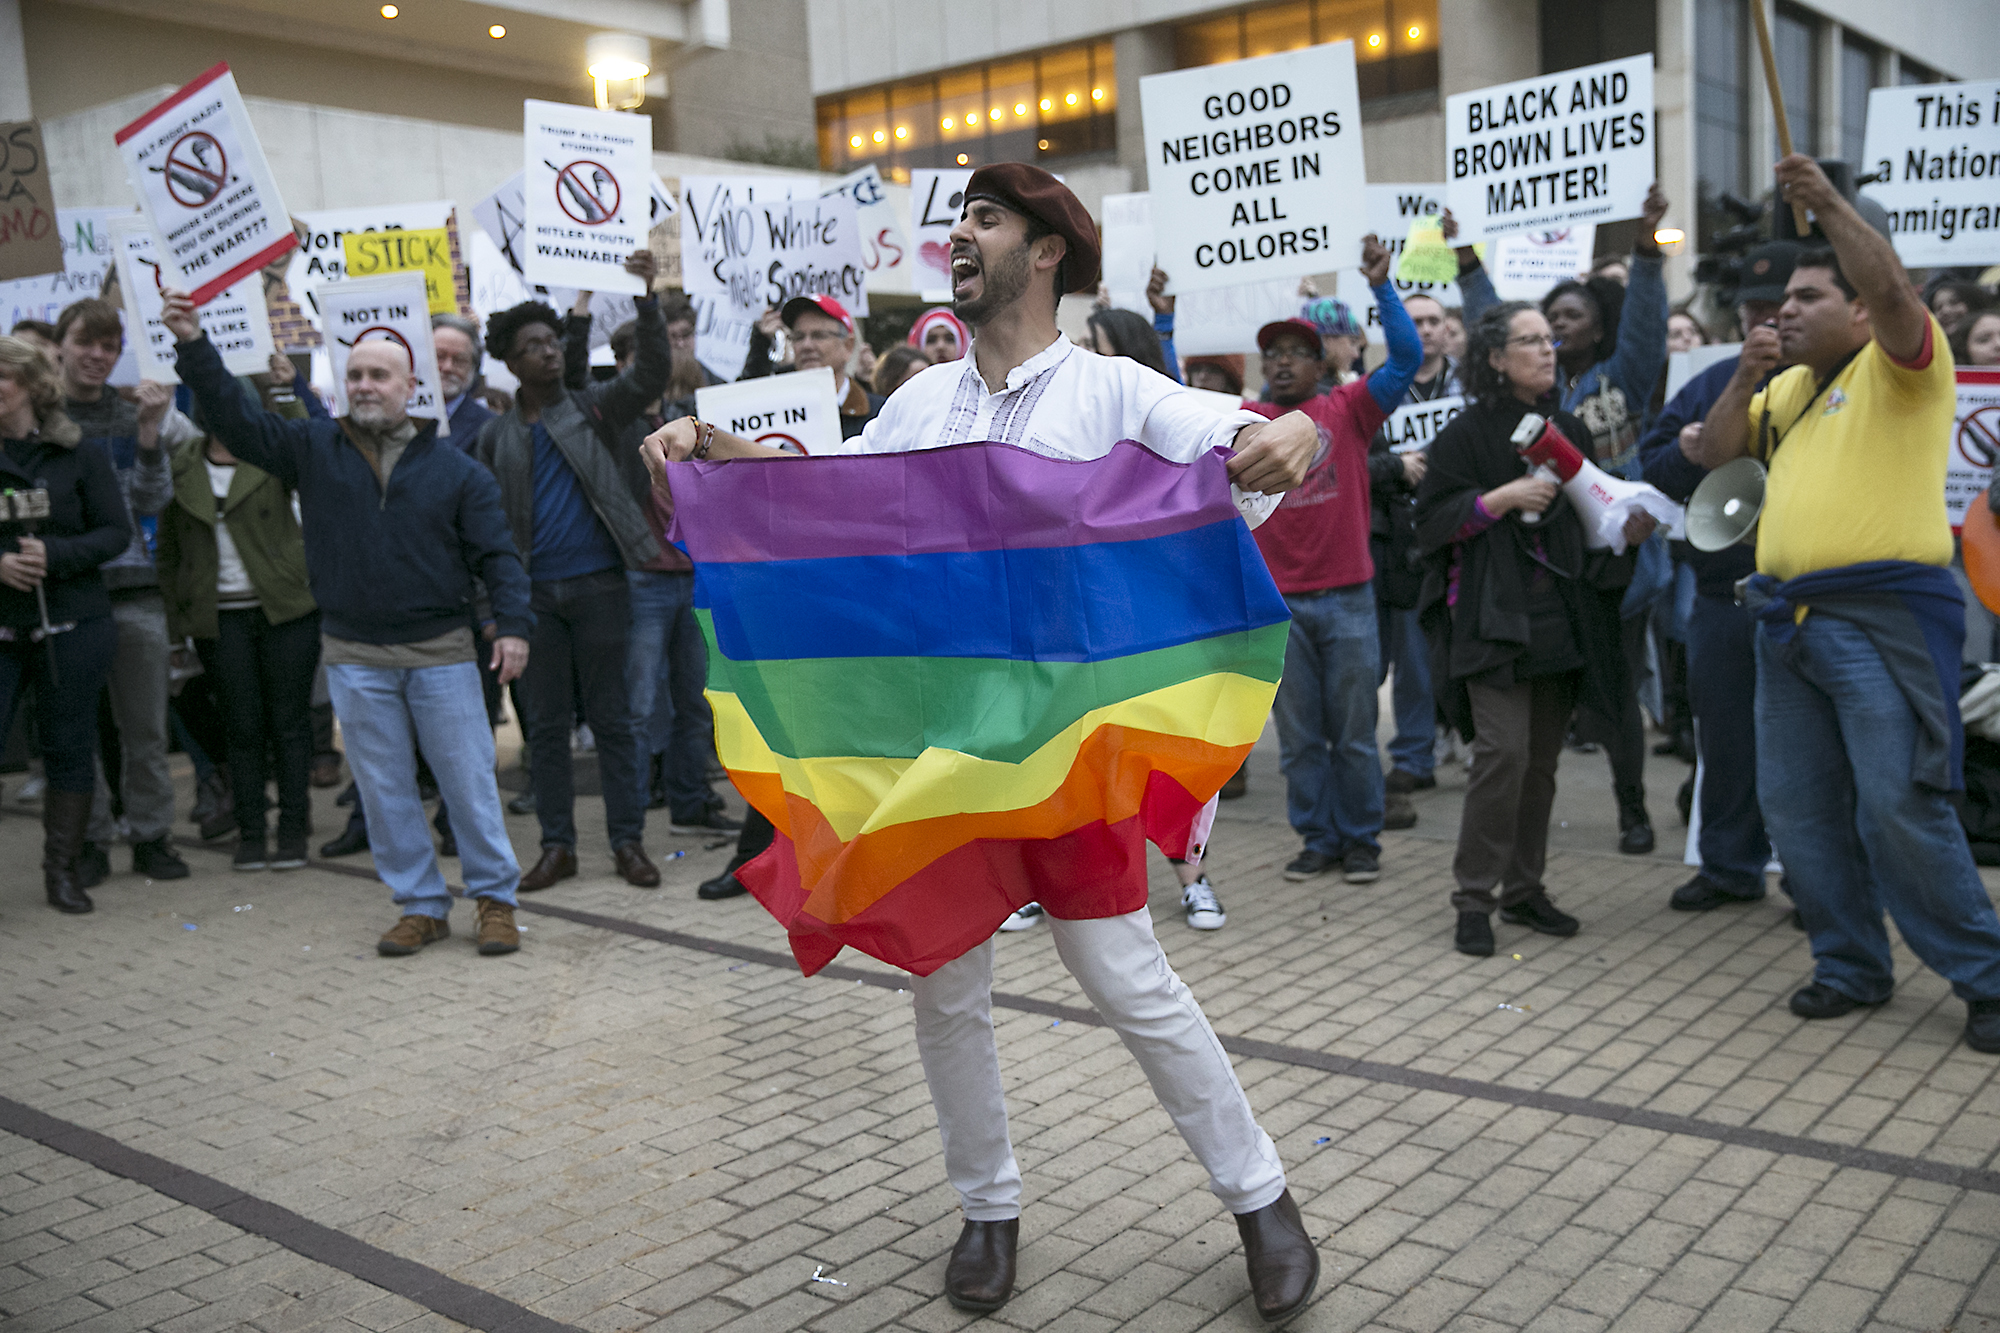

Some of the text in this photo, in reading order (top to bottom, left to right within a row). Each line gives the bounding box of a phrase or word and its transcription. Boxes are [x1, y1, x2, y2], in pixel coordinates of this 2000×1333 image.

[1205, 84, 1292, 120] GOOD
[1469, 72, 1628, 133] BLACK AND
[1917, 94, 1980, 128] This
[1162, 111, 1341, 165] NEIGHBORS
[1454, 113, 1645, 179] BROWN LIVES
[1191, 152, 1321, 196] COME IN
[1487, 164, 1608, 216] MATTER!
[1876, 160, 1892, 182] a
[167, 218, 201, 242] WHOSE
[203, 204, 226, 220] SIDE
[173, 200, 262, 258] YOU ON DURING
[765, 205, 838, 250] White
[1231, 197, 1287, 227] ALL
[180, 251, 211, 276] THE
[212, 216, 268, 258] WAR???
[358, 235, 450, 274] STICK
[537, 225, 635, 246] HITLER YOUTH
[1195, 225, 1329, 268] COLORS!
[342, 304, 409, 324] NOT IN
[731, 407, 806, 433] NOT IN
